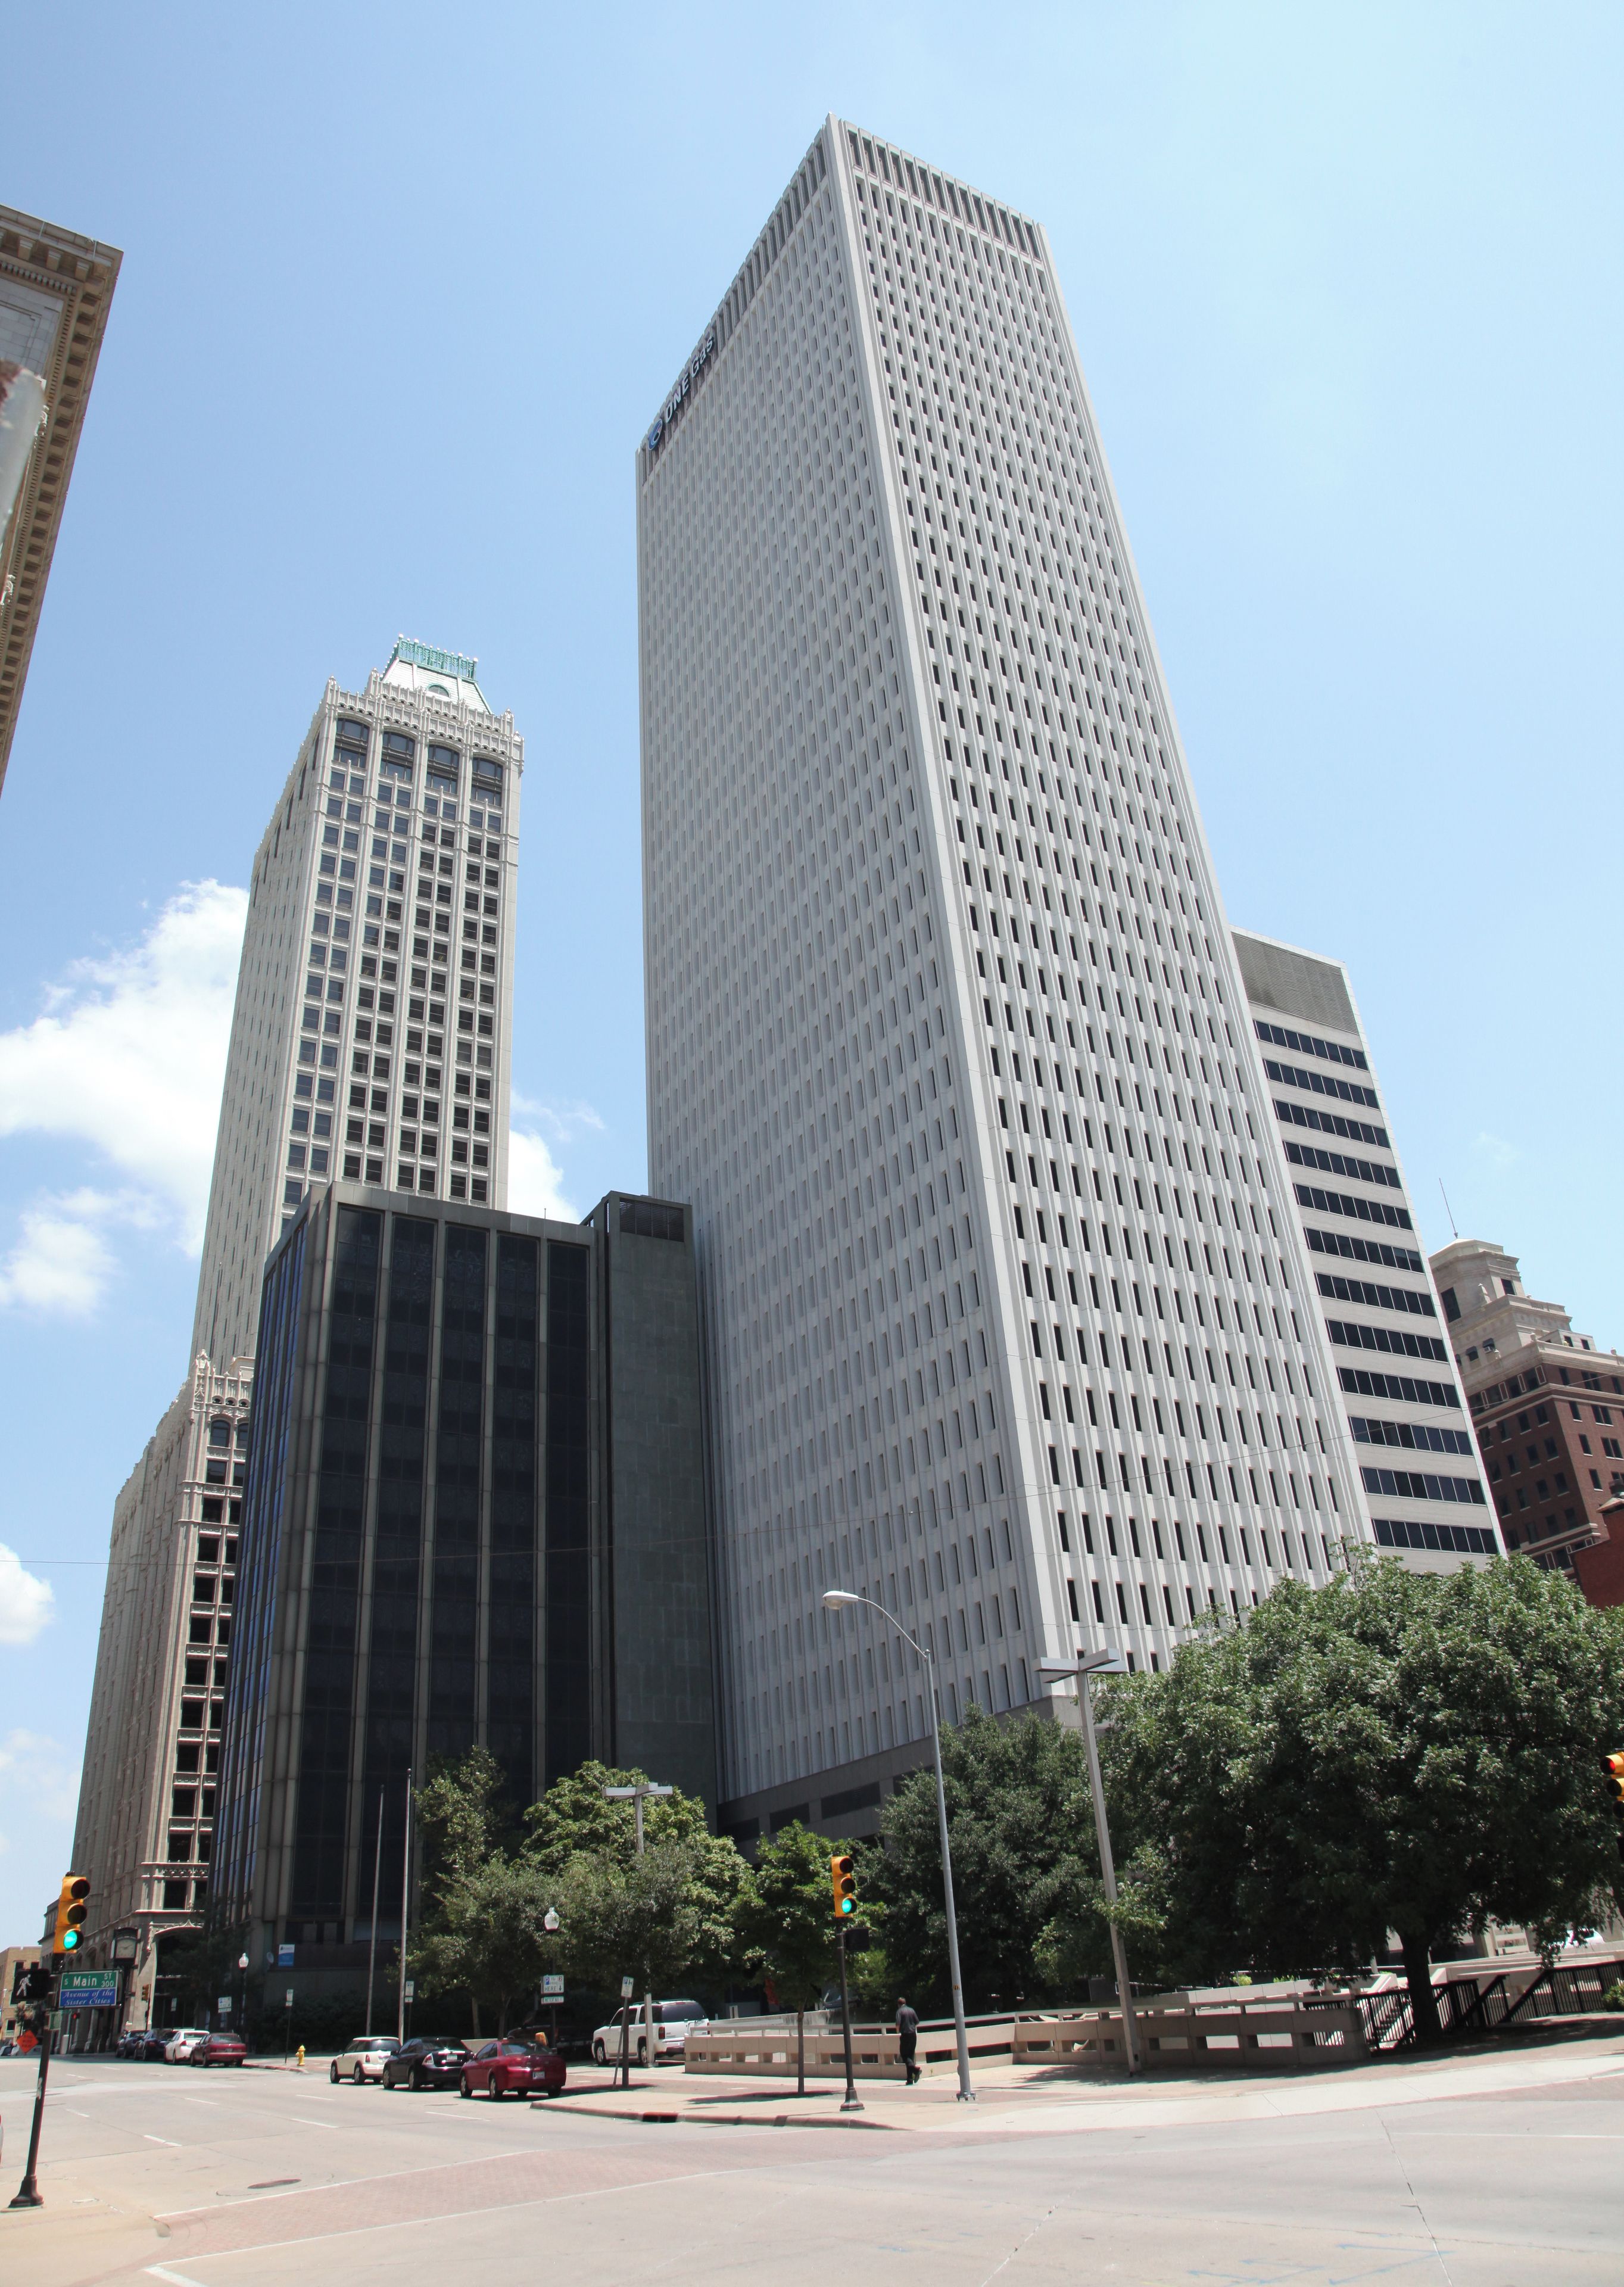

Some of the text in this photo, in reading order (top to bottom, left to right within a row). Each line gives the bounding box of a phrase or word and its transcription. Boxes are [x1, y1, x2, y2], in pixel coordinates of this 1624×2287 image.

[665, 336, 715, 423] ONE Gas
[73, 1976, 96, 1987] Main
[92, 1989, 100, 1998] of
